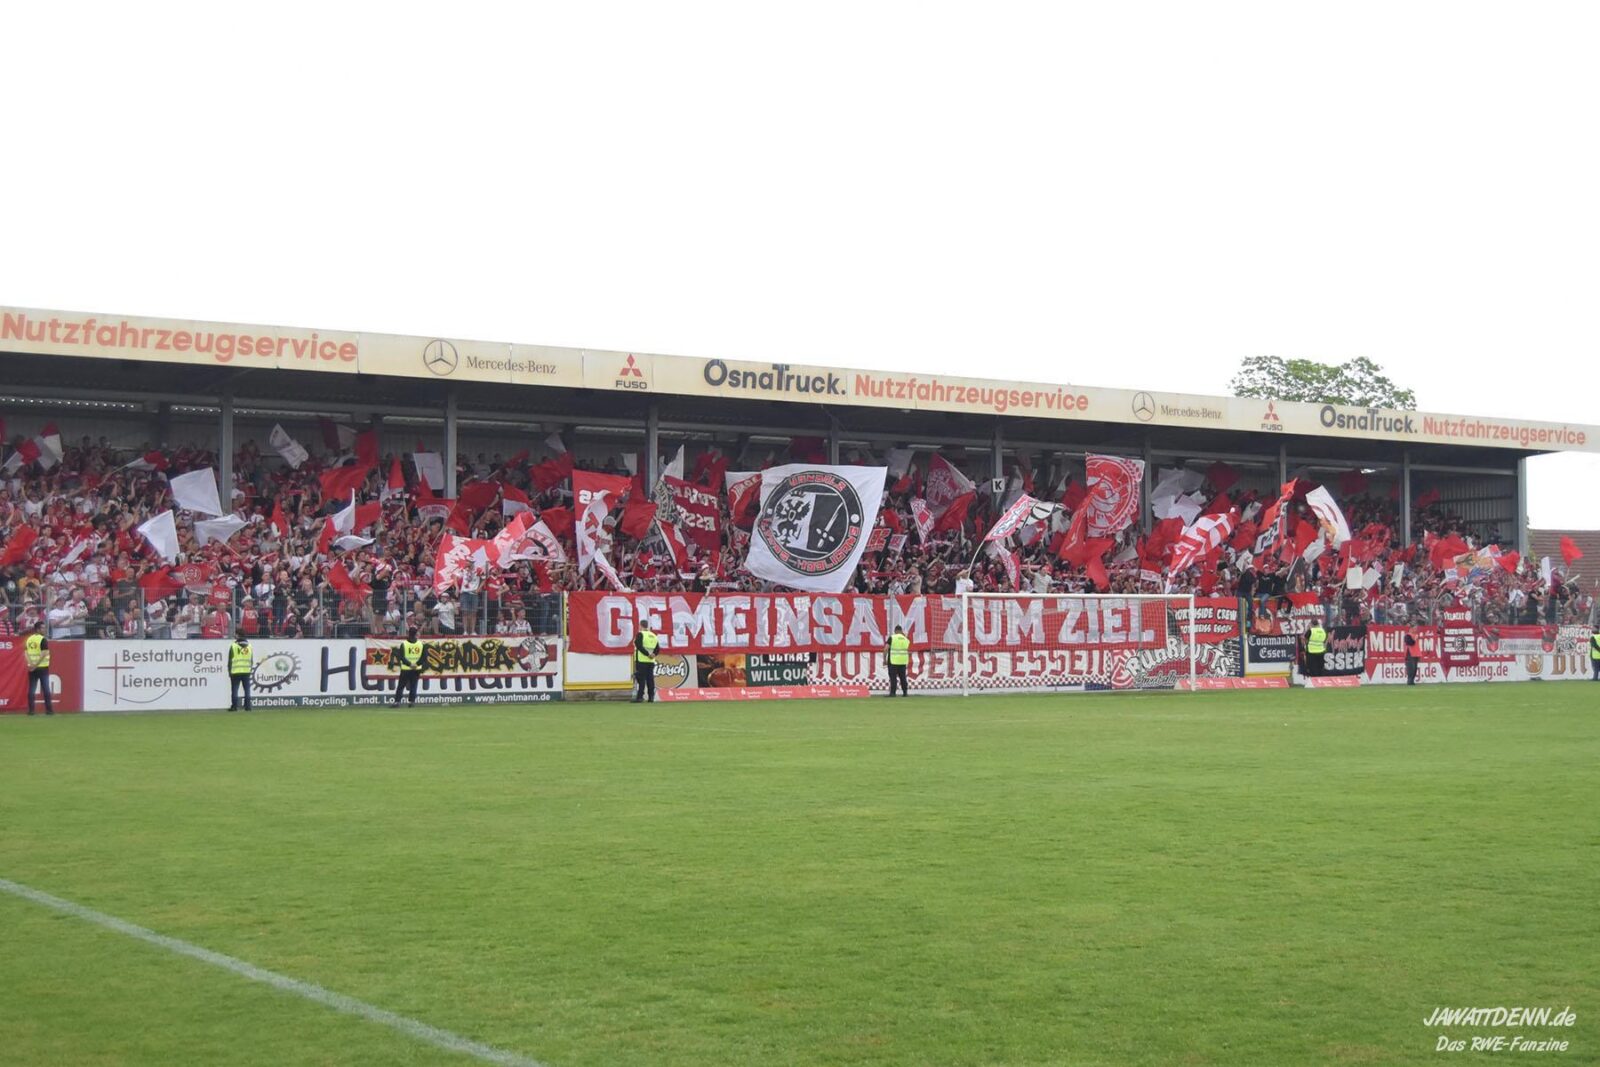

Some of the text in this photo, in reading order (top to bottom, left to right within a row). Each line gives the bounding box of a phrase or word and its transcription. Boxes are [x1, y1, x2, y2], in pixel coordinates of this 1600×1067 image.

[1, 312, 358, 363] Nutzfahrzeugservice
[466, 356, 556, 375] Mercedes-Benz
[615, 380, 648, 390] FUSO
[703, 358, 1090, 413] OsnaTruck. Nutzfahrzeugservice
[1160, 404, 1222, 420] Mercedes-Benz
[1260, 423, 1283, 432] FUSO
[1319, 404, 1586, 448] OsnaTruck. Nutzfahrzeugservice
[994, 480, 1004, 491] K
[596, 595, 1155, 648] GEMEINSAM ZUM ZIEL
[1248, 634, 1296, 646] Commando
[122, 649, 223, 665] Bestattungen
[408, 646, 421, 655] K9
[1258, 647, 1287, 659] Essen
[815, 651, 876, 681] ROT
[1010, 649, 1106, 677] ESSEN
[1323, 650, 1365, 671] SSEN
[193, 665, 223, 674] GmbH
[750, 669, 780, 682] WILL
[1381, 663, 1437, 682] leissg.de
[1455, 664, 1509, 682] leissing.de
[122, 674, 208, 688] Lienemann
[475, 692, 551, 704] www.huntmann.de
